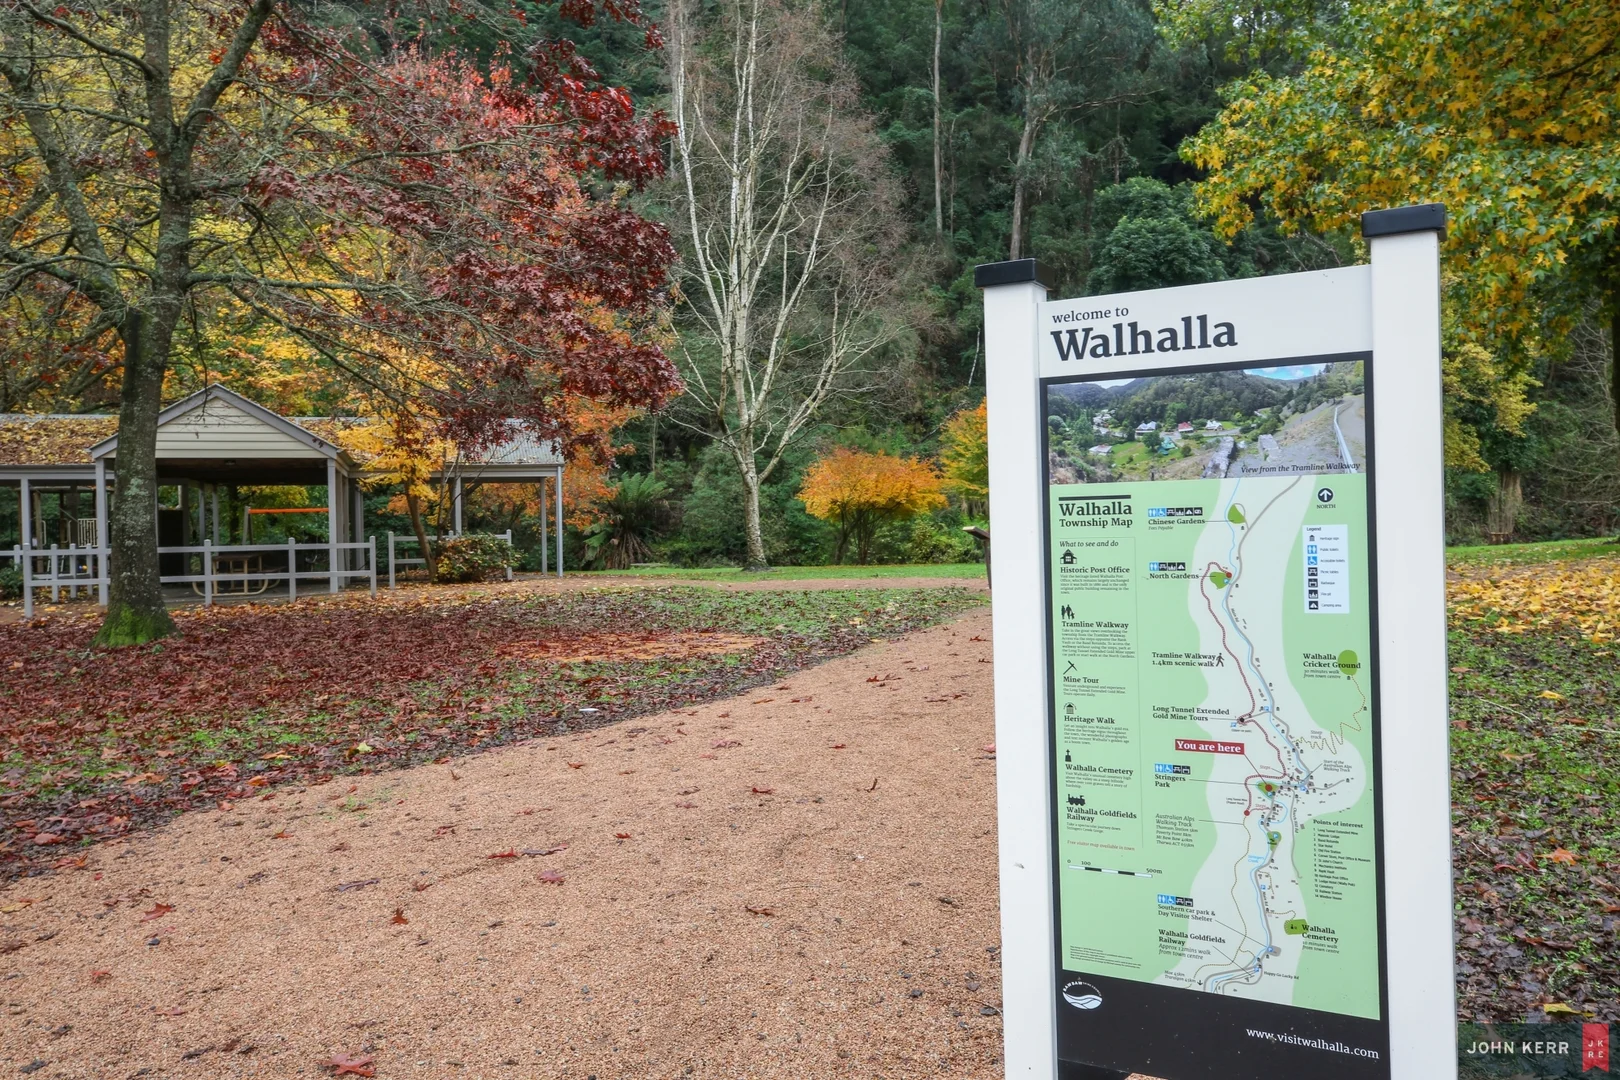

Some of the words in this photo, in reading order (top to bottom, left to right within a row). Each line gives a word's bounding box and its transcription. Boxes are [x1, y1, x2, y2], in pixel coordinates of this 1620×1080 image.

[1052, 308, 1111, 323] welcome
[1115, 308, 1129, 317] to
[1050, 314, 1238, 361] Walhalla
[1259, 466, 1276, 474] from
[1059, 502, 1132, 516] Walhalla
[1059, 518, 1108, 528] Township
[1111, 518, 1132, 528] Map
[1064, 716, 1094, 724] Heritage
[1177, 741, 1196, 750] You
[1218, 743, 1241, 752] here
[1098, 766, 1133, 776] Cemetery
[1067, 807, 1098, 815] Walhalla
[1100, 810, 1137, 818] Goldfields
[1067, 814, 1094, 822] Railway
[1302, 924, 1335, 934] Walhalla
[1159, 929, 1188, 938] Walhalla
[1190, 933, 1226, 943] Goldfields
[1159, 937, 1185, 946] Railway
[1302, 932, 1338, 943] Cemetery
[1246, 1028, 1380, 1059] www.visitwalhalla.com
